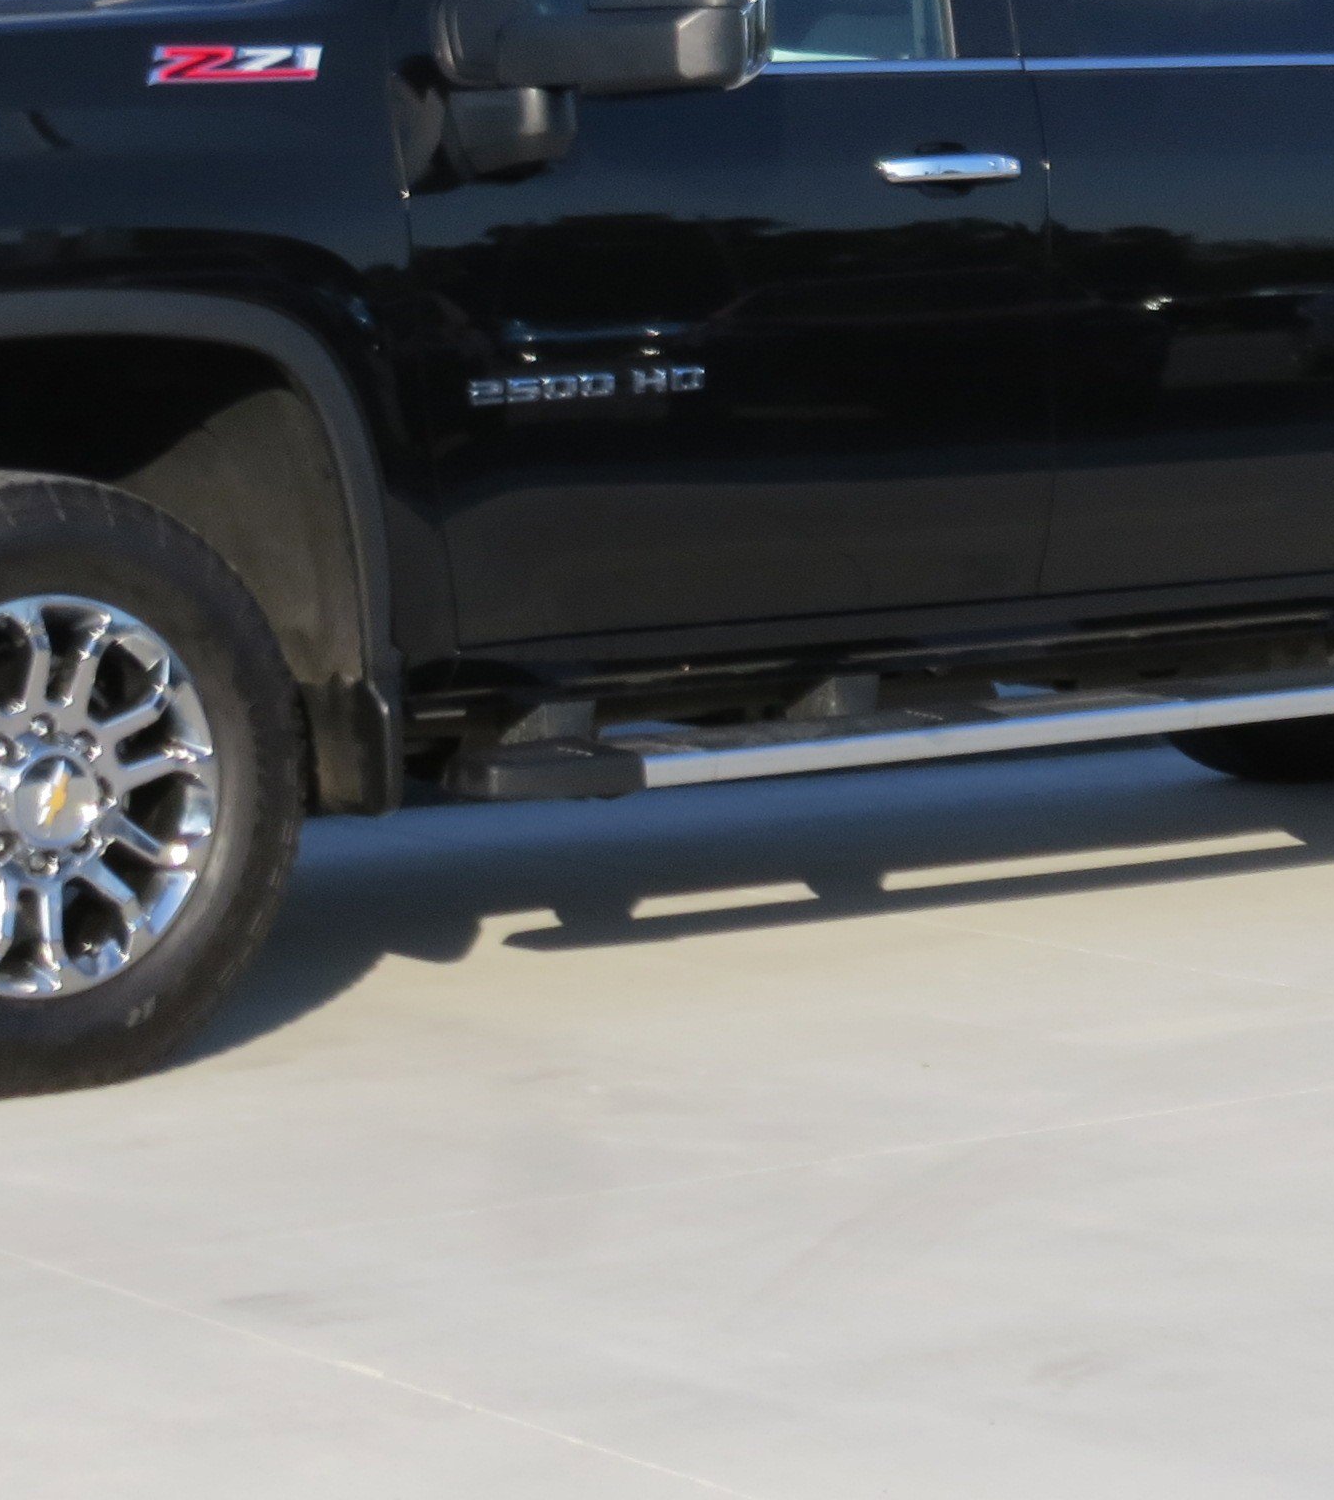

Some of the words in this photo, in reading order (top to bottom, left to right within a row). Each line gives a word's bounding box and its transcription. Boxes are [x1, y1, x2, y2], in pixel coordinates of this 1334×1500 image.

[148, 45, 323, 86] Z71
[469, 373, 615, 406] 2500
[630, 367, 705, 394] HD
